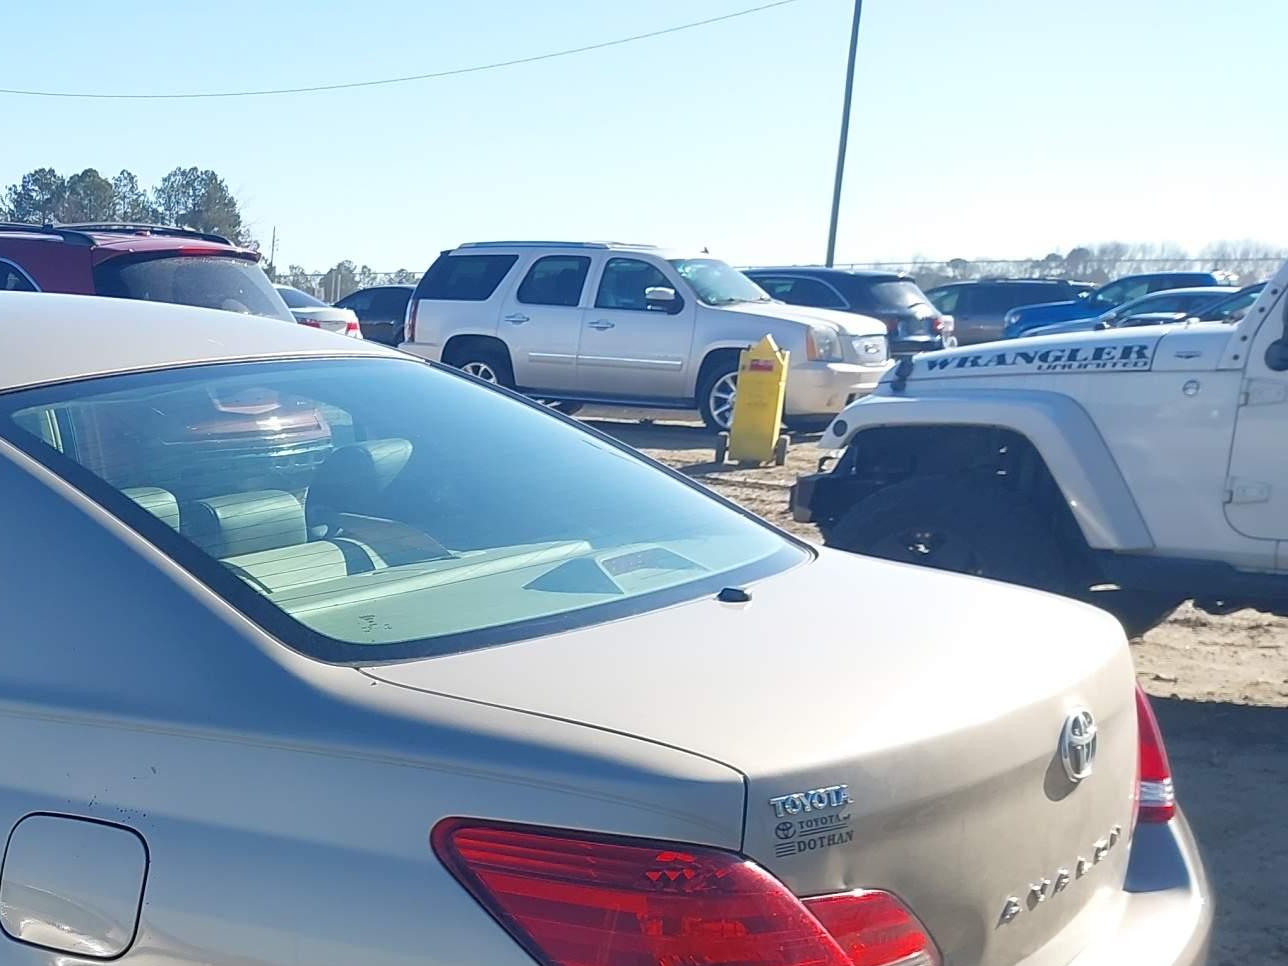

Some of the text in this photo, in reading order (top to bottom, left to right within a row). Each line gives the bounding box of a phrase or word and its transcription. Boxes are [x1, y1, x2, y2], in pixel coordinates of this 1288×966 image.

[927, 345, 1149, 371] WRANGLER
[769, 784, 854, 818] TOYOTA
[798, 814, 841, 829] TOYOTA
[797, 830, 854, 852] DOTHAN
